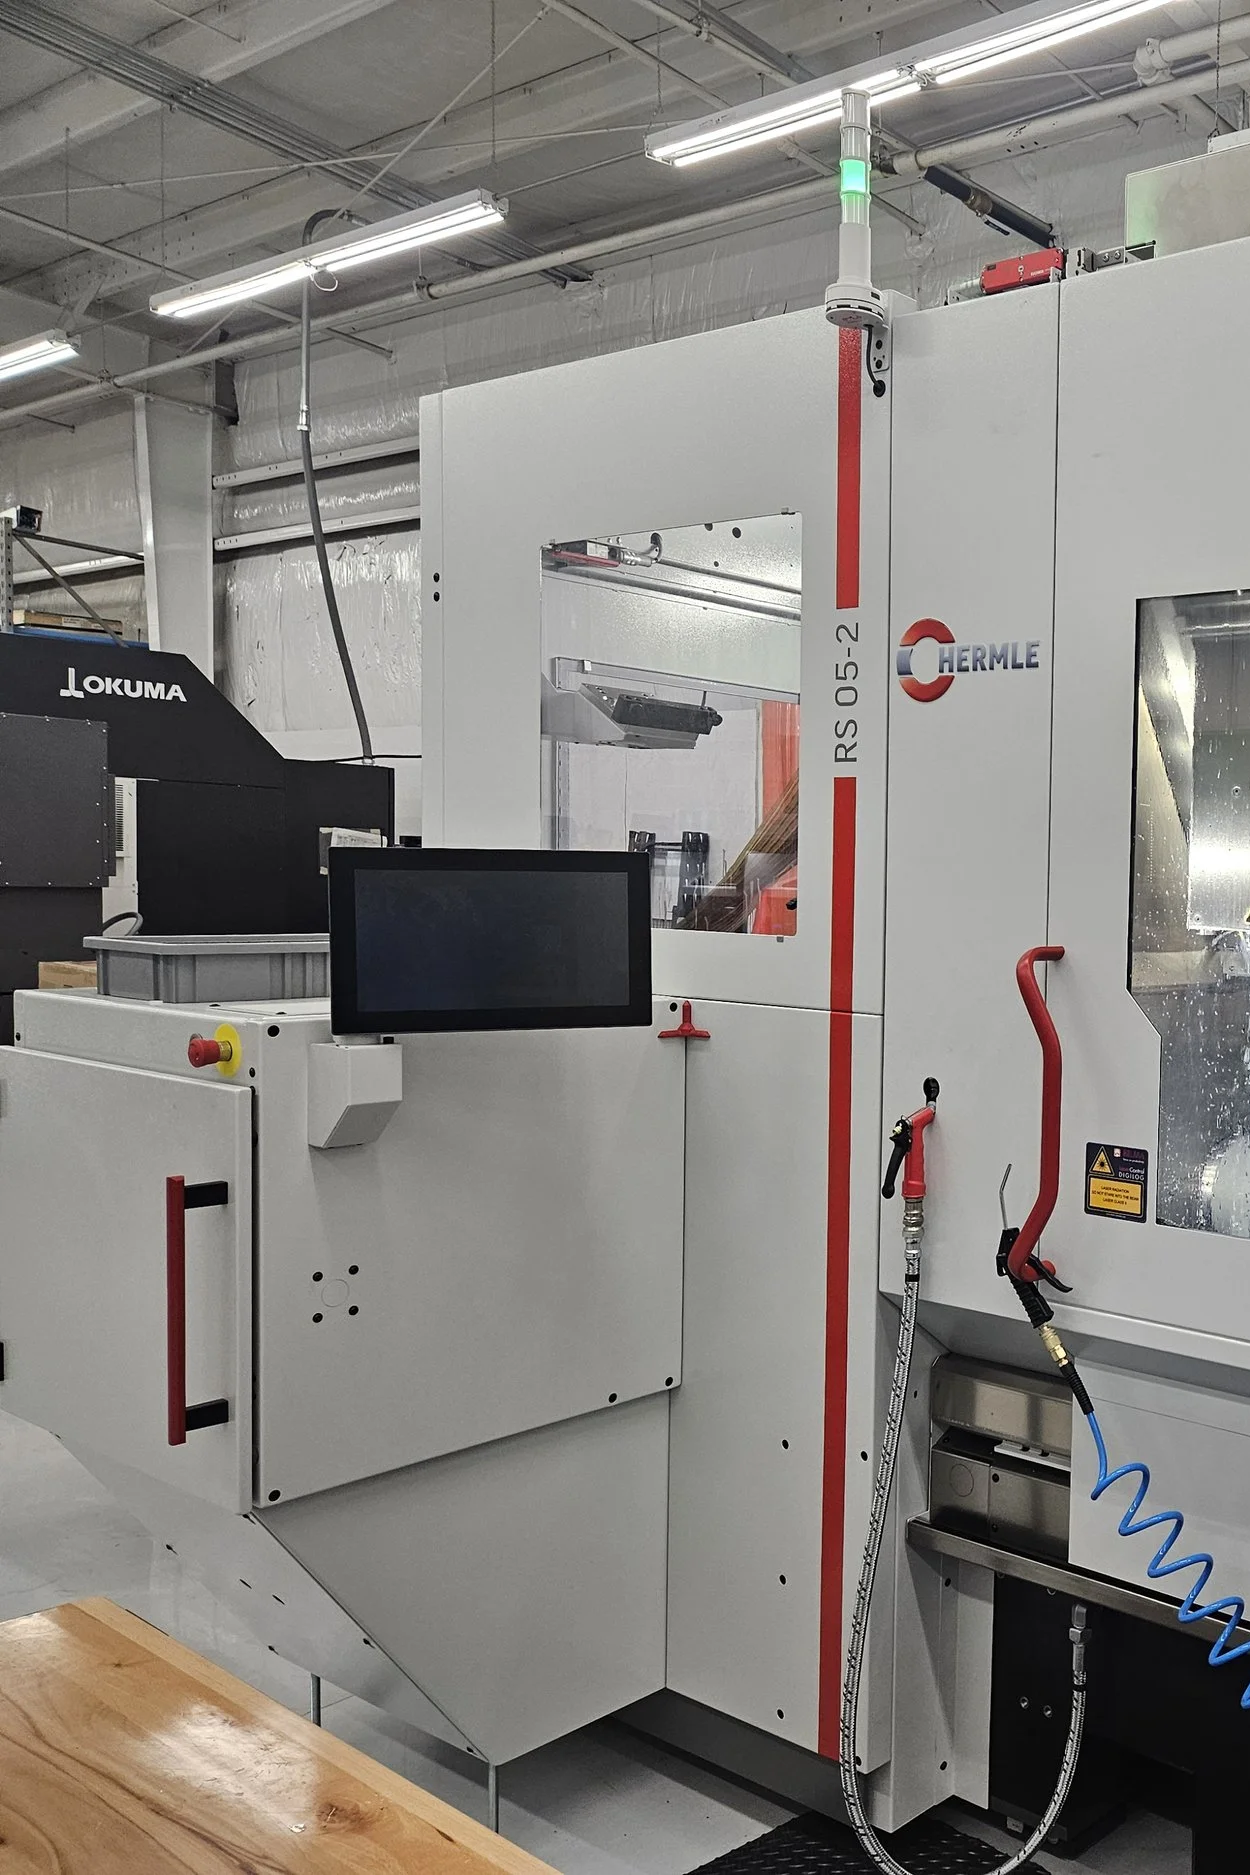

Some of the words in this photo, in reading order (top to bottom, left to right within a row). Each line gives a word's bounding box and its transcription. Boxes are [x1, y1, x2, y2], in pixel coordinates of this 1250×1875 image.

[834, 622, 859, 707] 05-2
[938, 640, 1041, 674] HERMLE
[82, 674, 188, 702] OKUMA
[834, 718, 858, 763] RS
